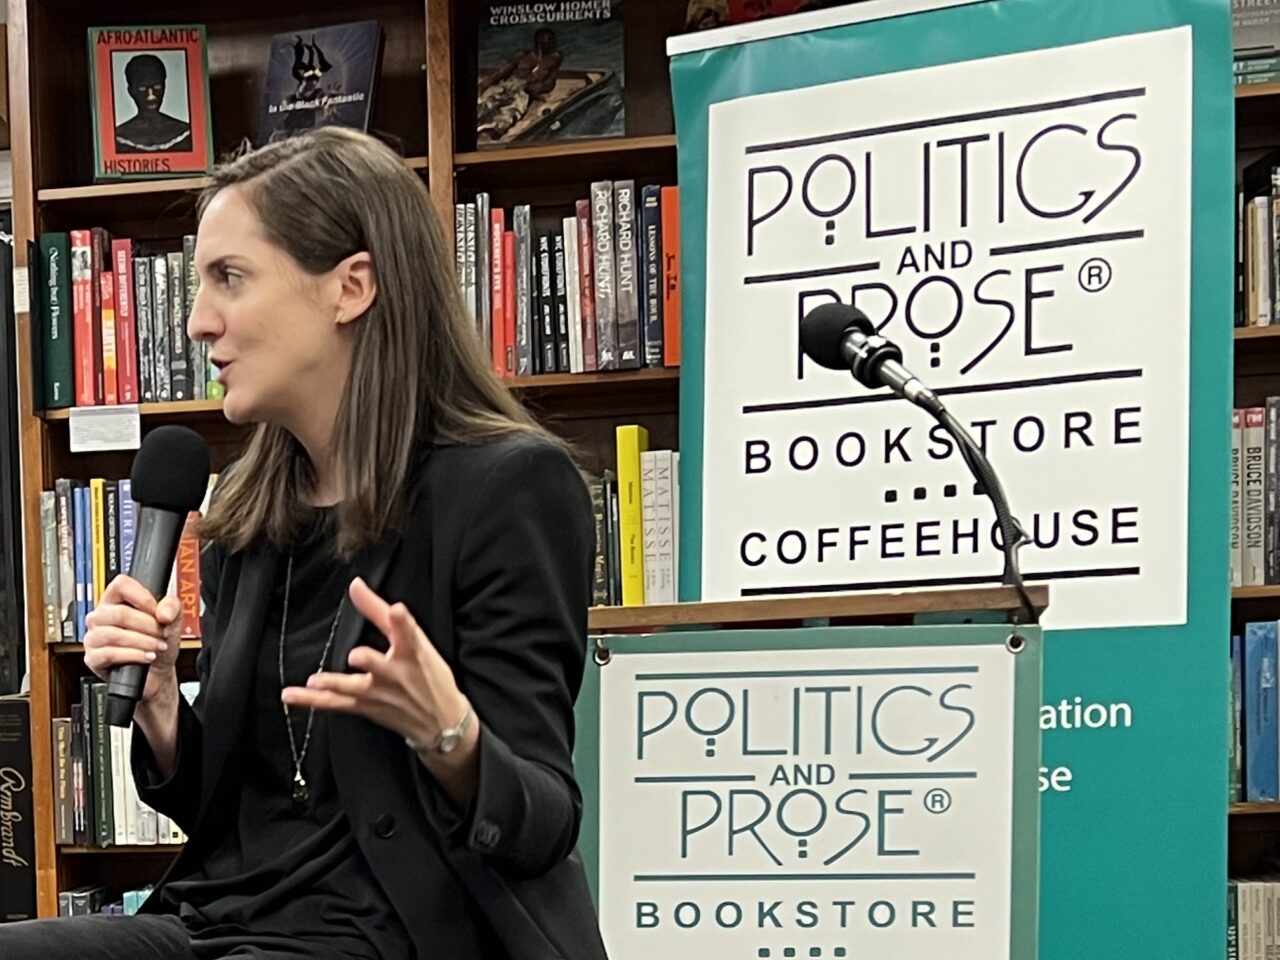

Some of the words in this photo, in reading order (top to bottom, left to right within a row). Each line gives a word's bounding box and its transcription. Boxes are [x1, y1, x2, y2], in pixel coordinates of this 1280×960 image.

[490, 4, 559, 16] WINSLOW
[565, 1, 610, 12] HOMER
[490, 9, 611, 25] CROSSCURRENTS
[103, 157, 171, 174] HISTORIES
[746, 113, 1142, 257] POLITICS
[596, 191, 610, 251] RICHARD
[618, 189, 632, 251] RICHARD
[648, 225, 657, 261] LESSONS
[896, 239, 973, 276] AND
[597, 255, 612, 293] HUNT
[620, 254, 633, 293] HUNT
[649, 278, 658, 295] THE
[745, 406, 1142, 474] BOOKSTORE
[1246, 447, 1262, 486] BRUCE
[643, 468, 656, 563] MATISSE
[658, 466, 671, 560] MATISSE
[1246, 488, 1262, 549] DAVIDSON
[740, 506, 1139, 567] COFFEEHOUSE
[179, 578, 196, 618] ART
[636, 683, 976, 763] POLITICS
[770, 763, 836, 786] AND
[680, 787, 920, 866] PROSE
[635, 899, 975, 929] BOOKSTORE
